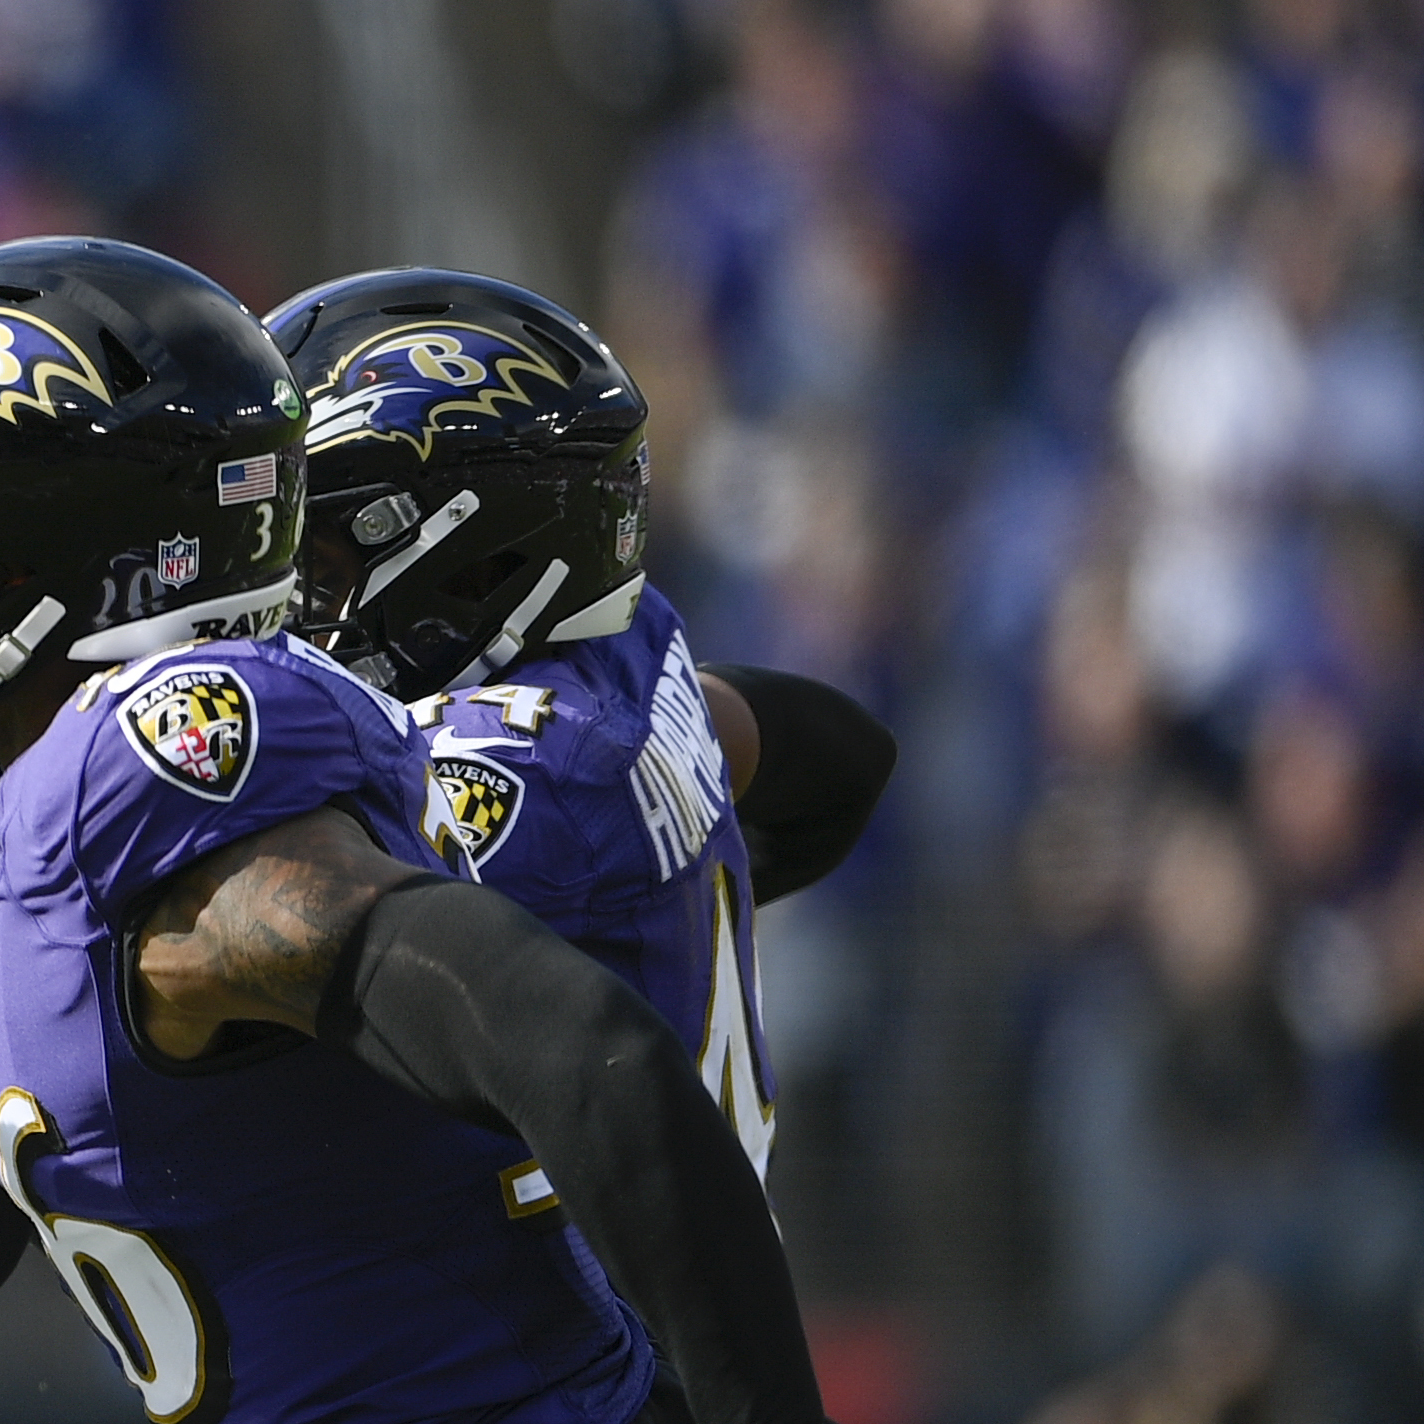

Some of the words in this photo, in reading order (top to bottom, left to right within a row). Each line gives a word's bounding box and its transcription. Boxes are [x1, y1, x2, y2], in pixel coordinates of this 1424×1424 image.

[379, 333, 488, 387] B
[164, 559, 195, 580] NFL
[131, 671, 225, 718] RAVENS
[434, 762, 510, 795] AVENS
